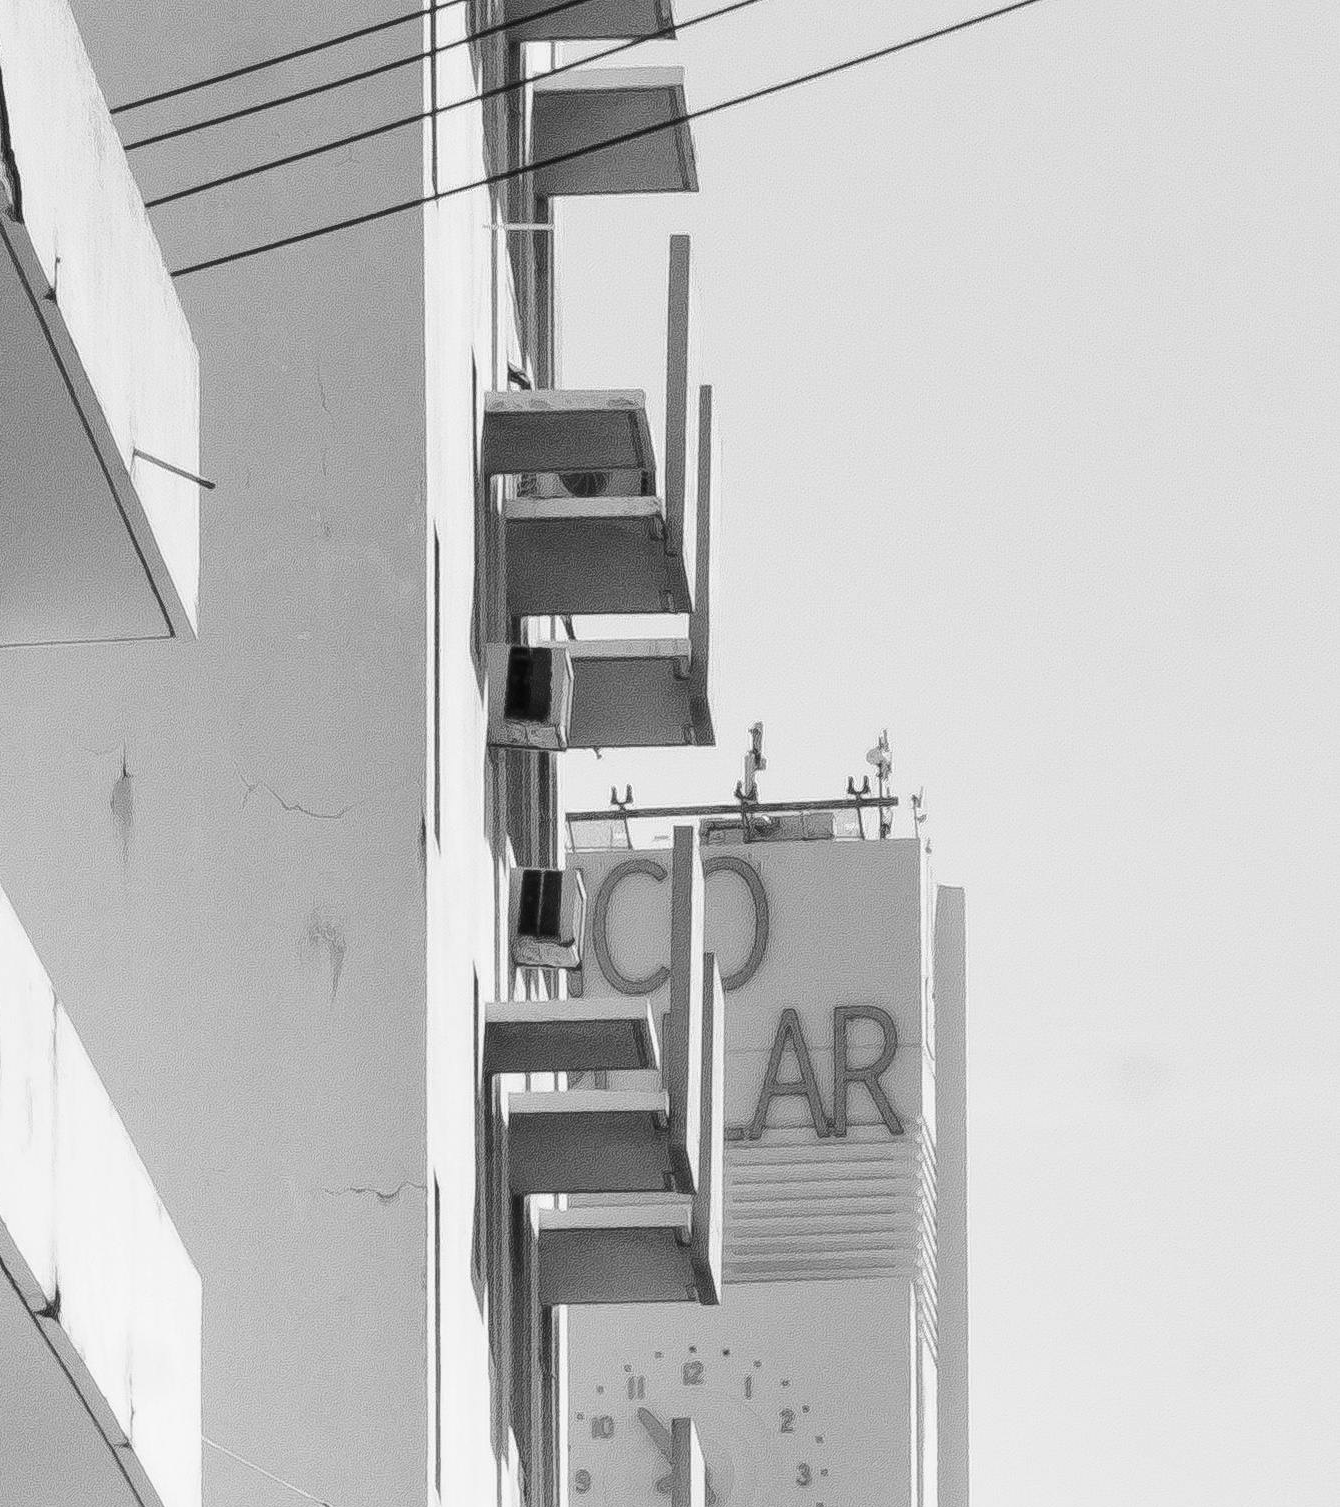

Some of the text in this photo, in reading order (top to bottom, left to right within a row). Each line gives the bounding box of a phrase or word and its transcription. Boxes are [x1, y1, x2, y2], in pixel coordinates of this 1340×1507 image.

[570, 856, 770, 998] CO
[724, 1005, 905, 1141] AR
[682, 1361, 704, 1385] 12
[591, 1416, 614, 1438] 10
[780, 1408, 795, 1433] 2
[575, 1469, 591, 1494] 9
[796, 1463, 812, 1486] 3
